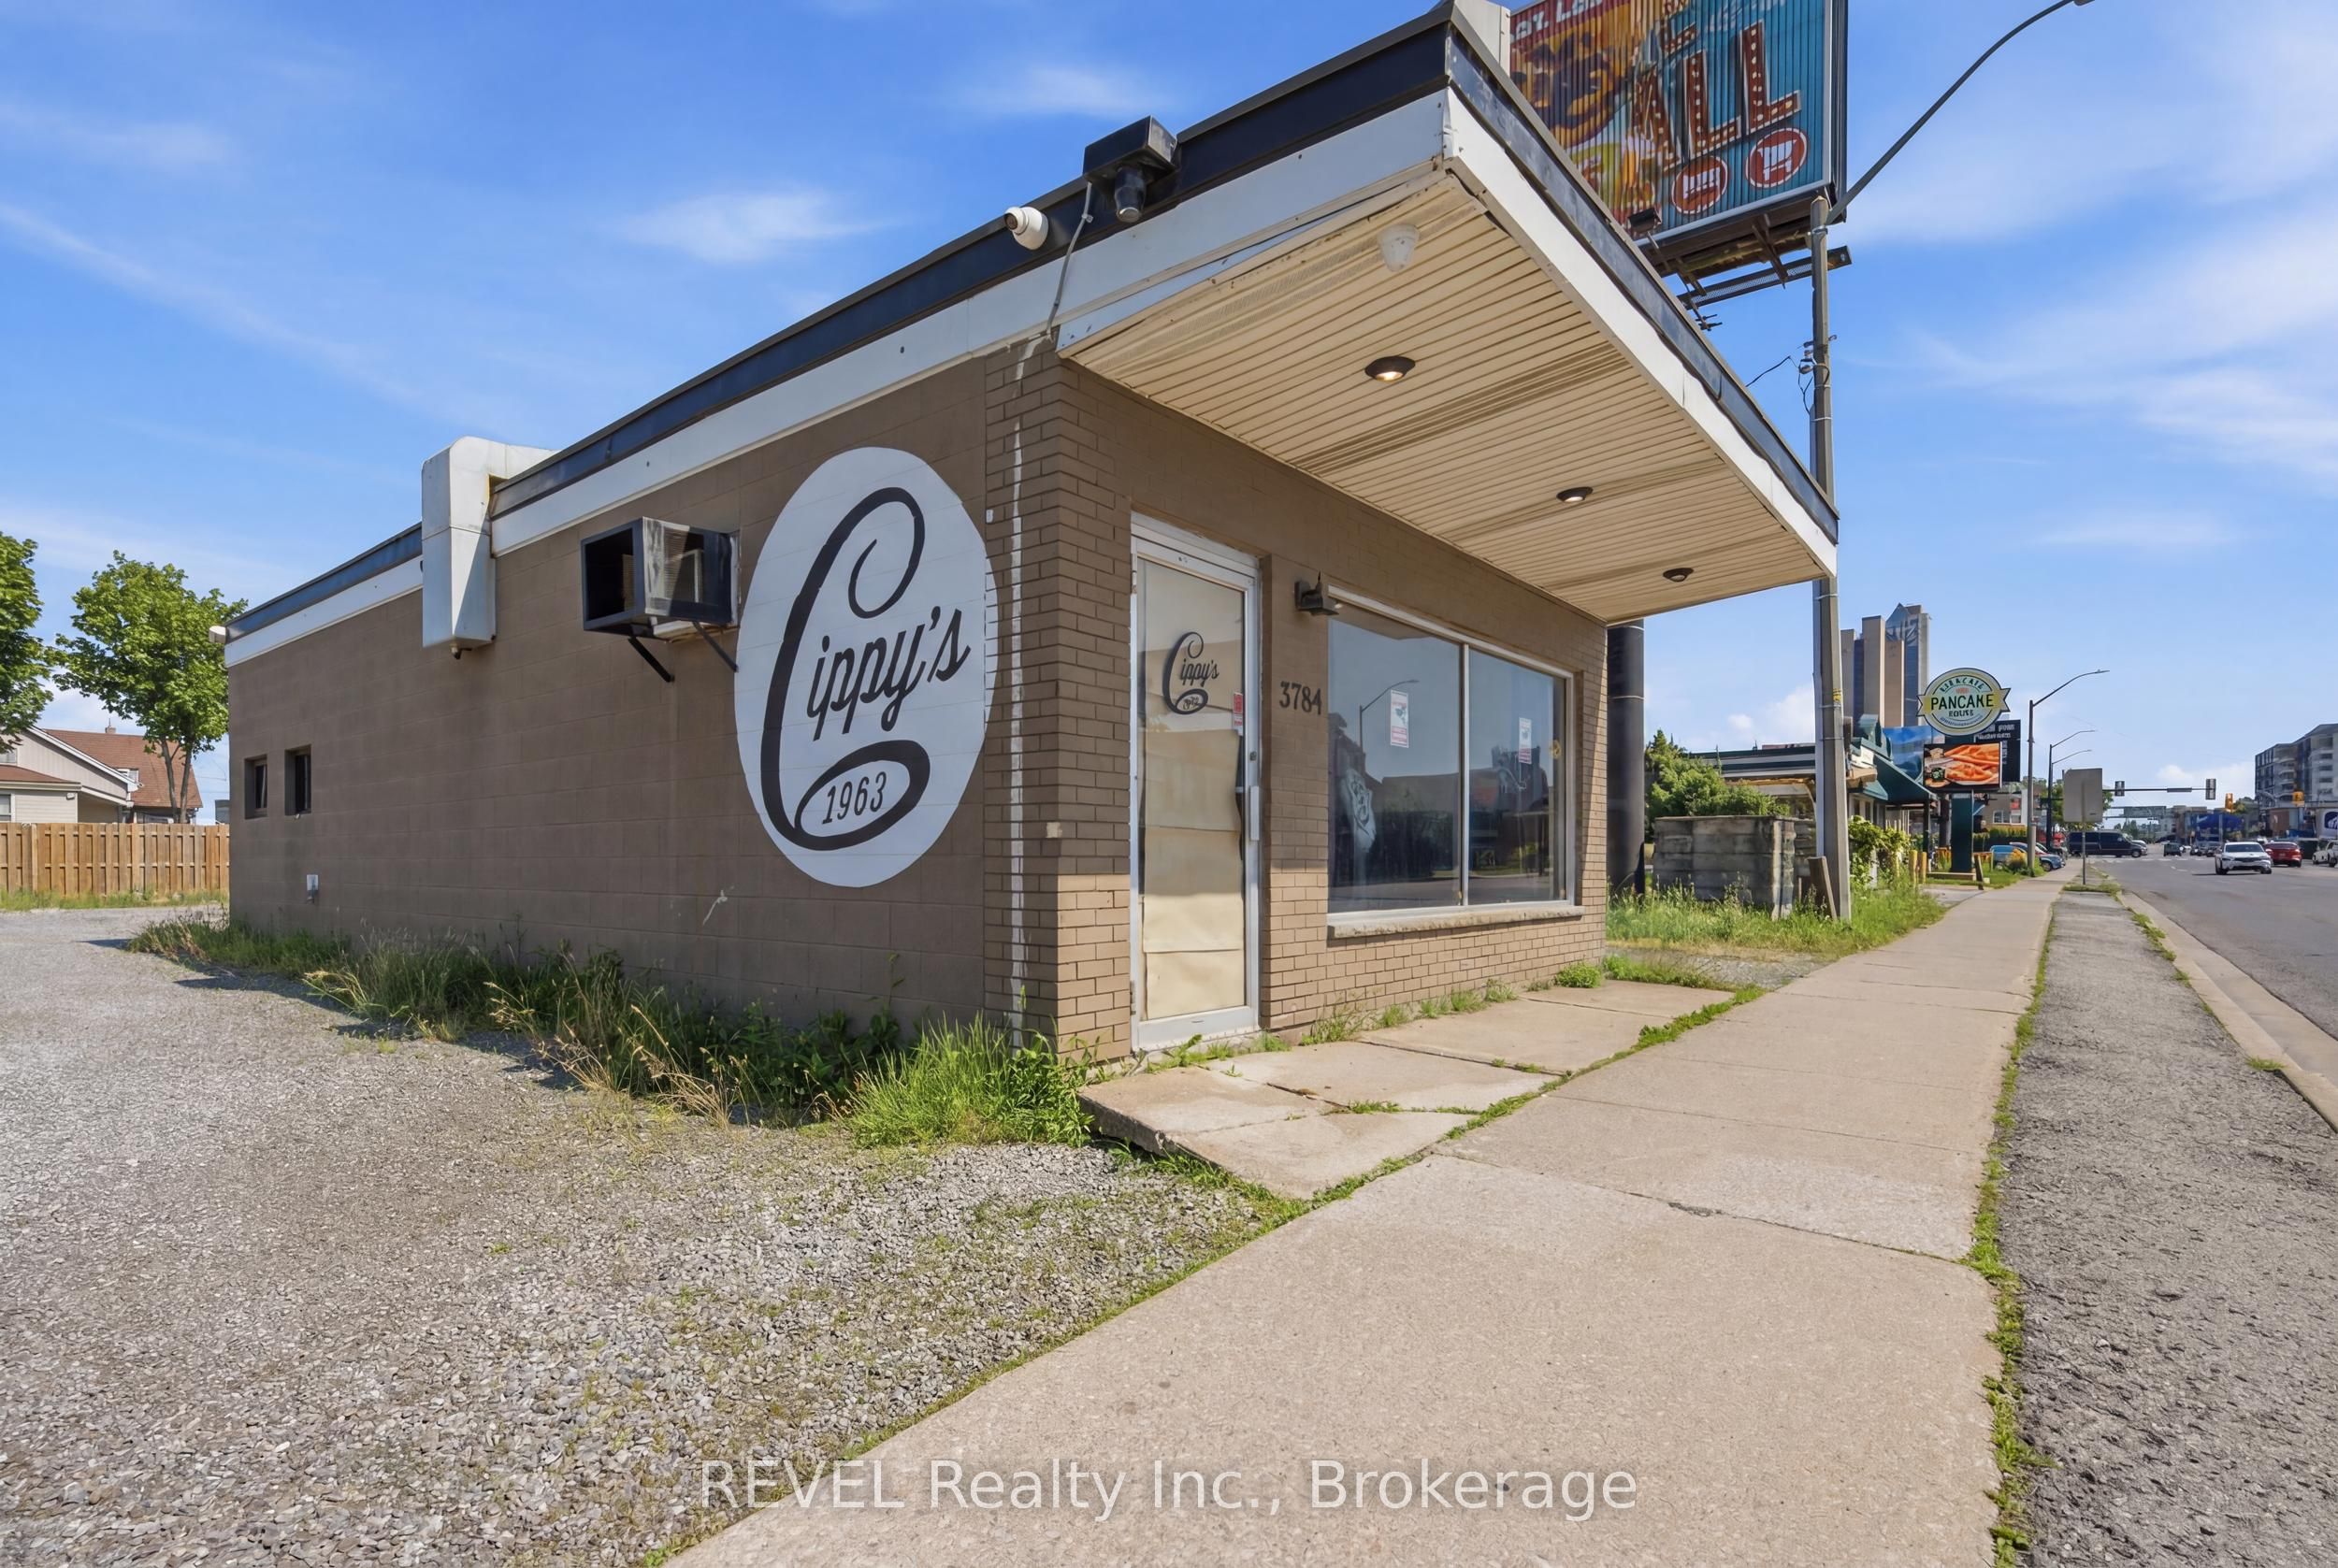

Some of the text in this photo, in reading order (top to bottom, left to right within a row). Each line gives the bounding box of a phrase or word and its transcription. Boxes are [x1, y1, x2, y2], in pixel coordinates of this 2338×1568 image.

[761, 486, 972, 852] Cippy's
[1162, 631, 1220, 715] Cippy's
[1279, 680, 1322, 715] 3784
[1930, 694, 1994, 711] PANCAKE
[821, 770, 888, 825] 1963
